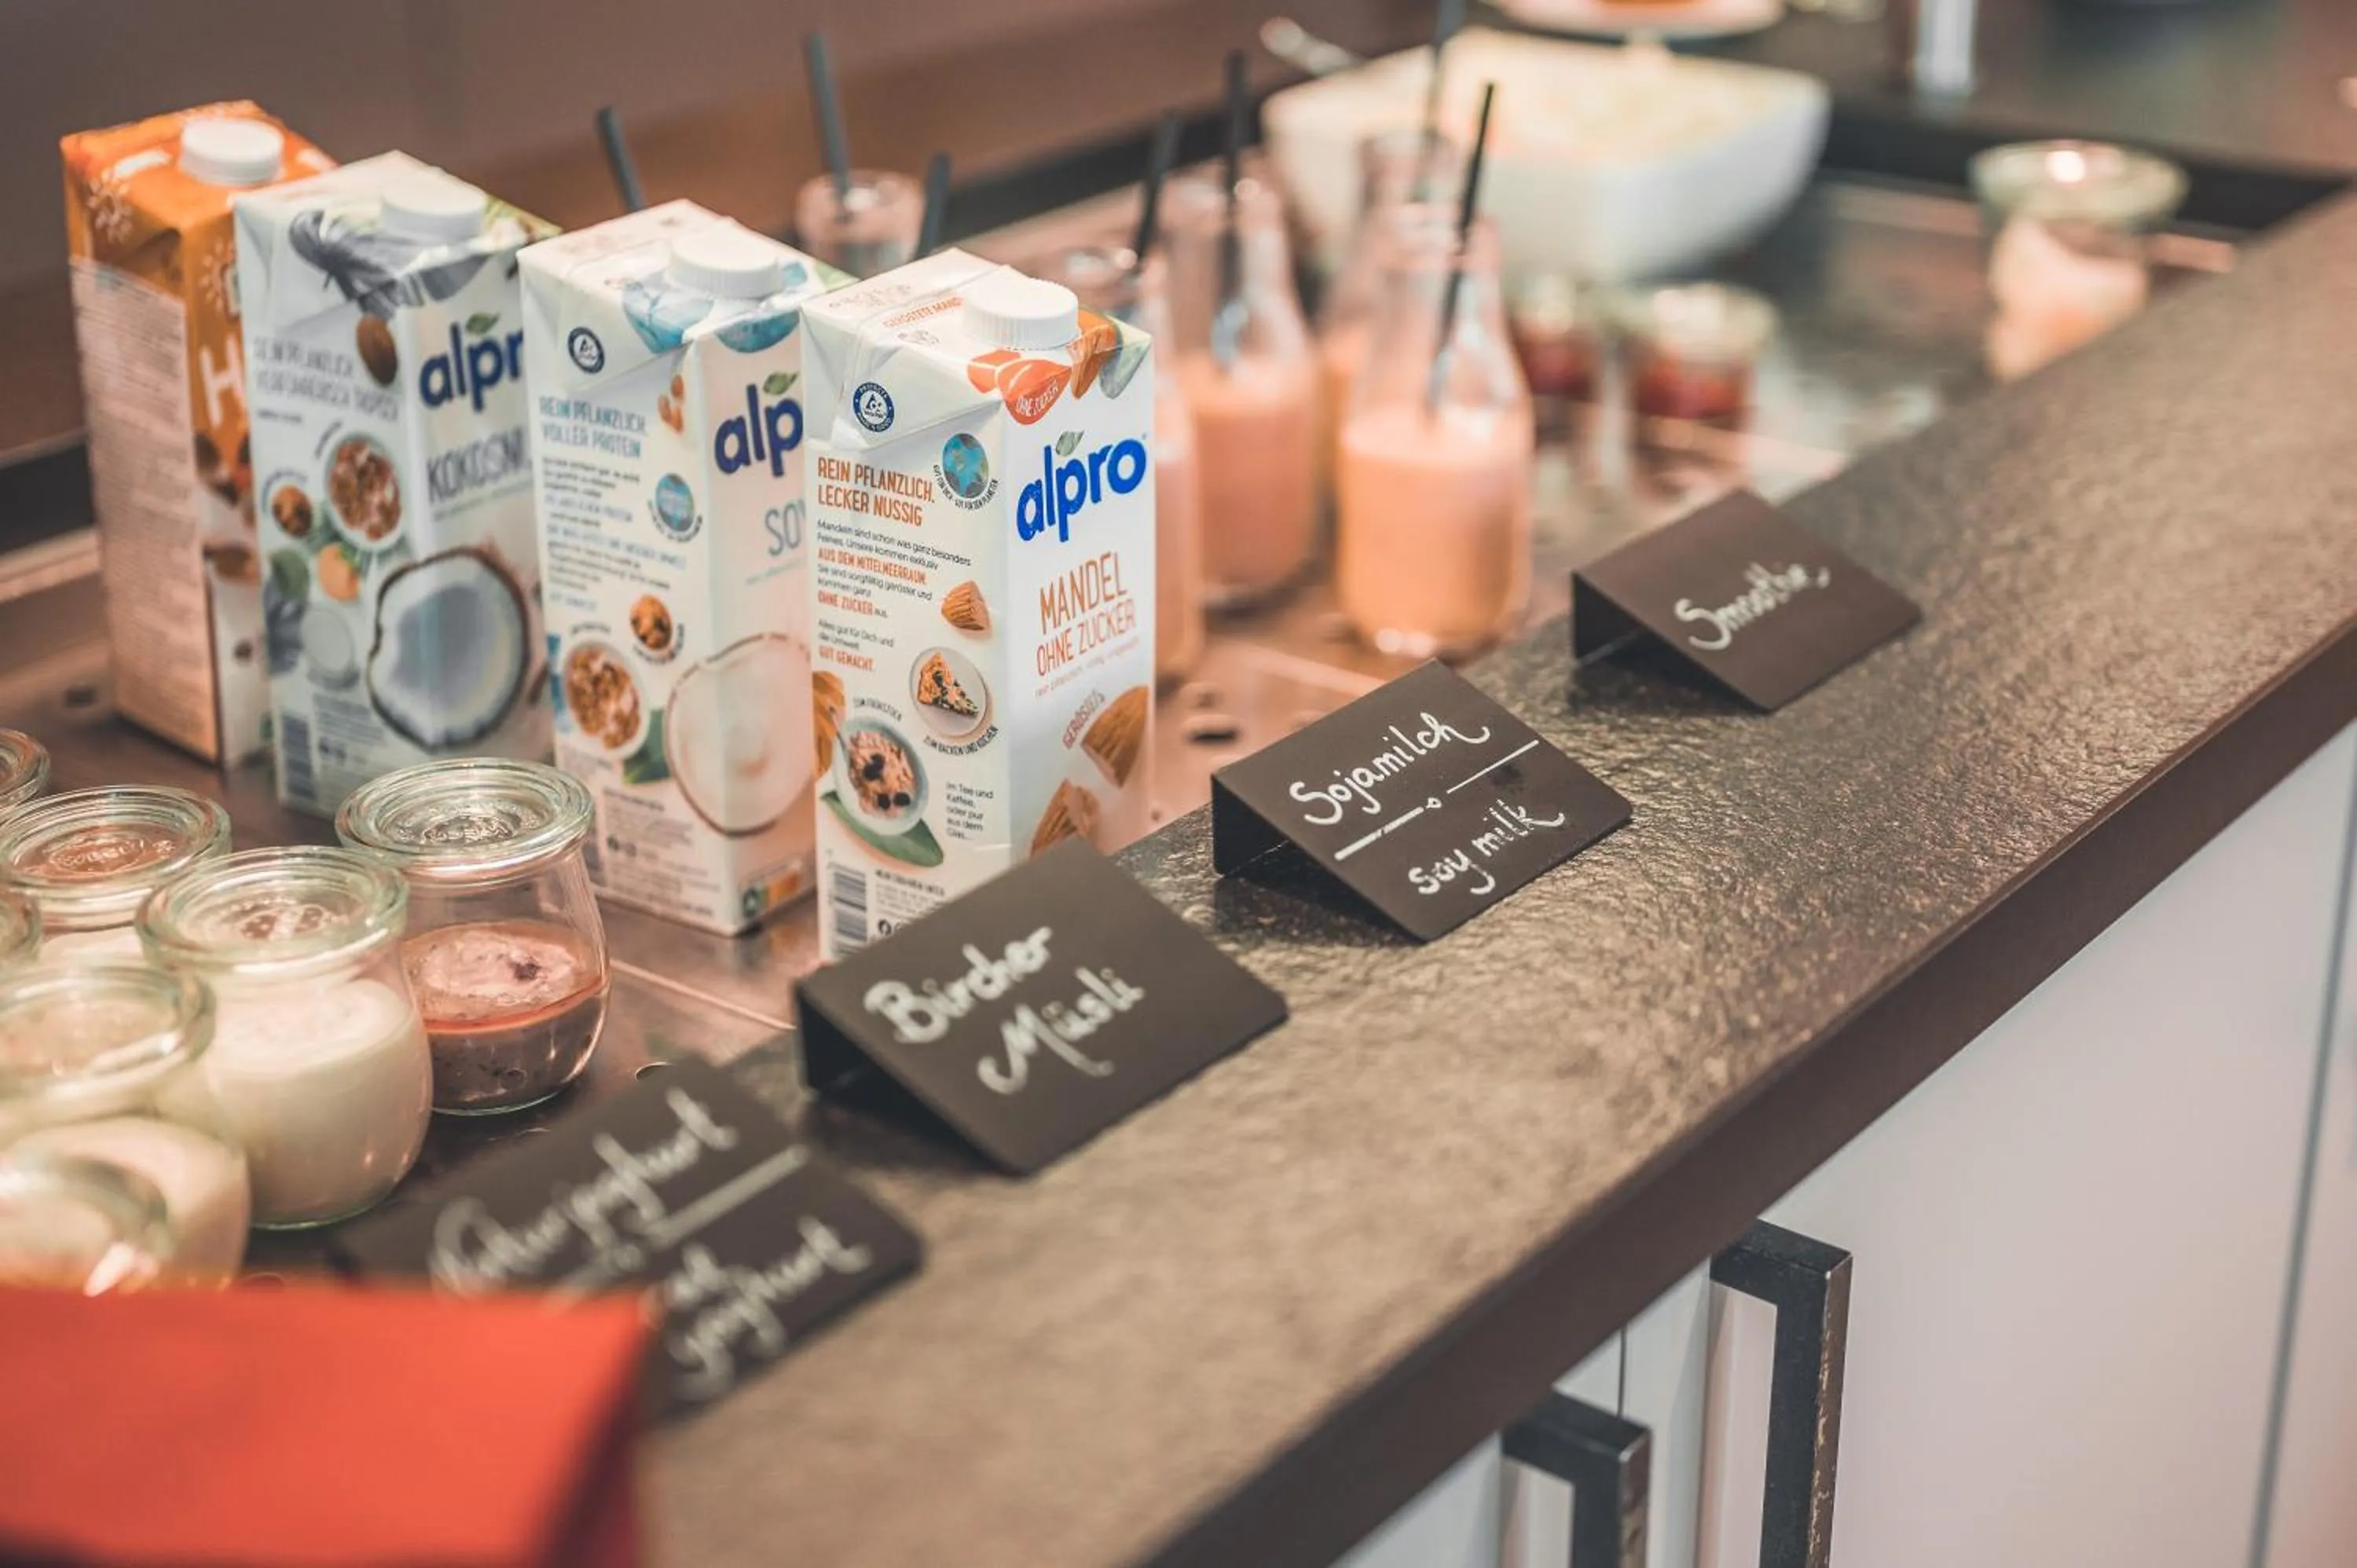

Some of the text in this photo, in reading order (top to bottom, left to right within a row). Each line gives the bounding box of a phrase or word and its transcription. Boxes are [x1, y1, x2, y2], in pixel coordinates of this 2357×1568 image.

[420, 322, 523, 412] alpr
[715, 383, 803, 478] alp
[818, 456, 935, 504] REIN PFLANZLICH.
[818, 484, 922, 526] LECKER NUSSIG
[1017, 438, 1146, 542] alpro
[1036, 628, 1074, 676] OHNE
[1077, 599, 1136, 654] ZUCKER
[1039, 551, 1127, 636] MANDEL
[1288, 711, 1490, 825] Sojamilch
[1408, 799, 1566, 896] soy milk
